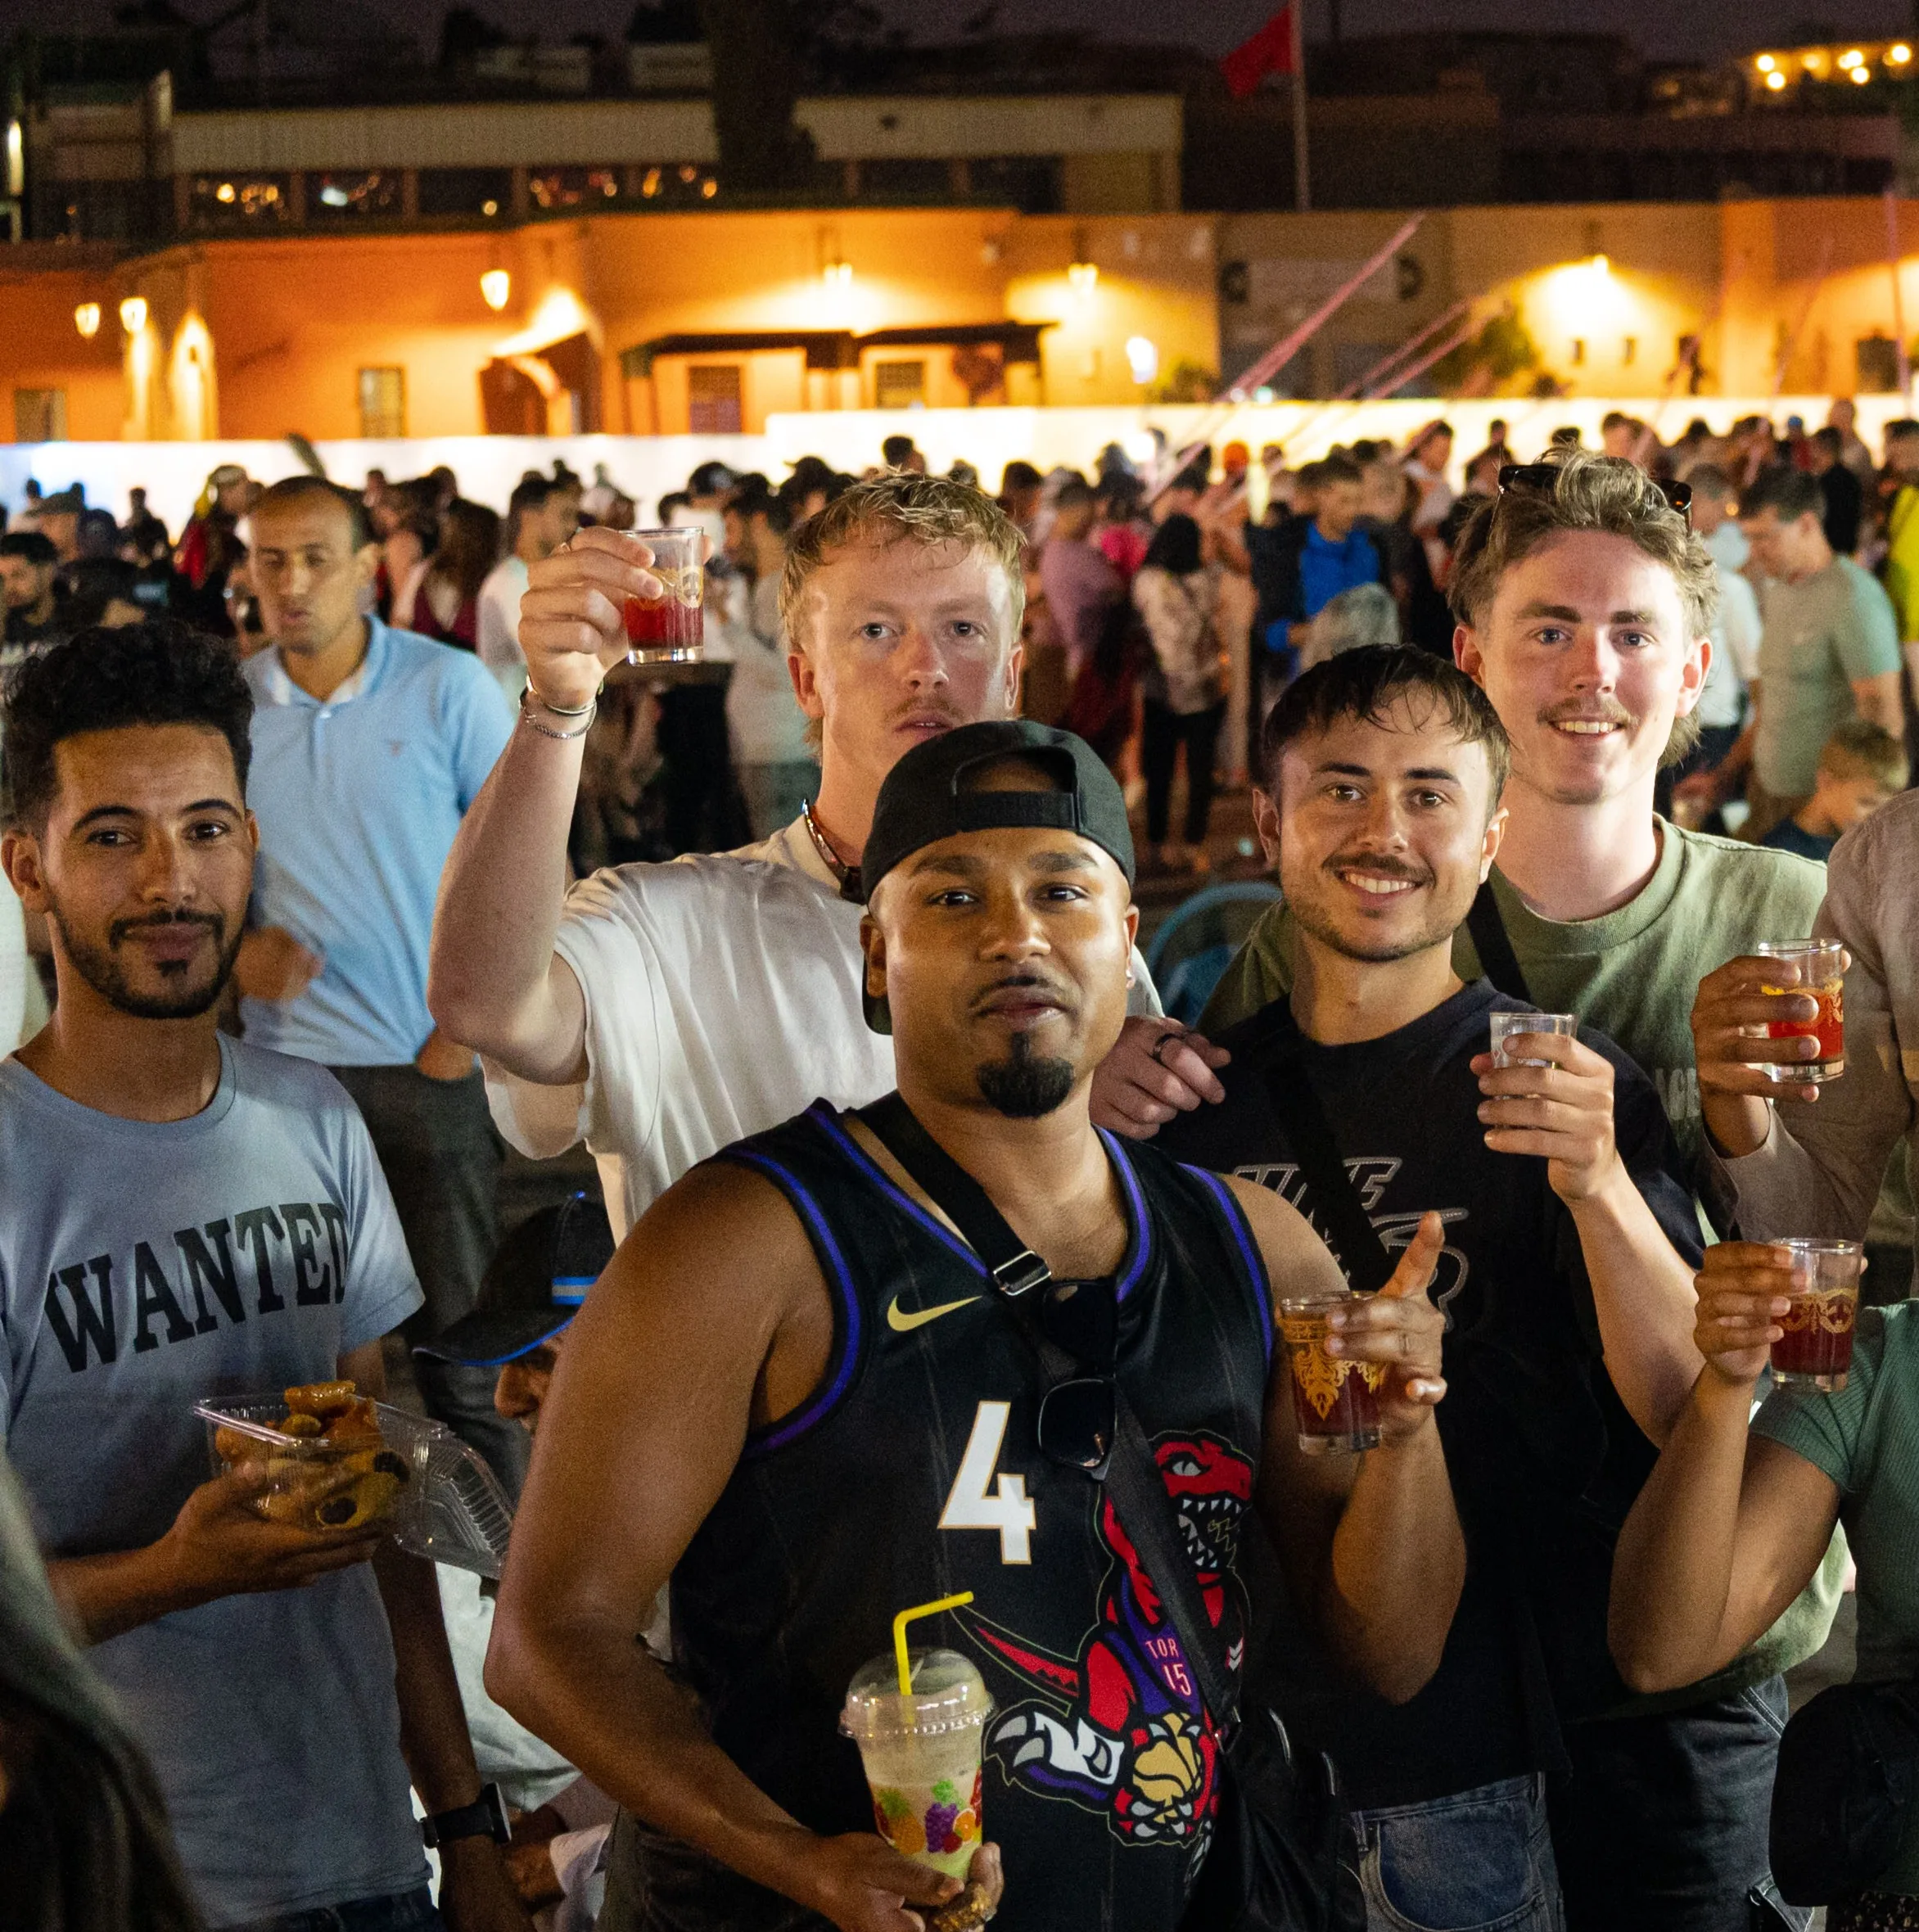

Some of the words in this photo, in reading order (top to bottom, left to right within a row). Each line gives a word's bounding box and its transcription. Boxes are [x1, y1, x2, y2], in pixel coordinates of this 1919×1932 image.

[44, 1203, 349, 1373] WANTED
[937, 1401, 1036, 1564] 4
[1145, 1638, 1179, 1660] TOR
[1163, 1663, 1192, 1696] 15
